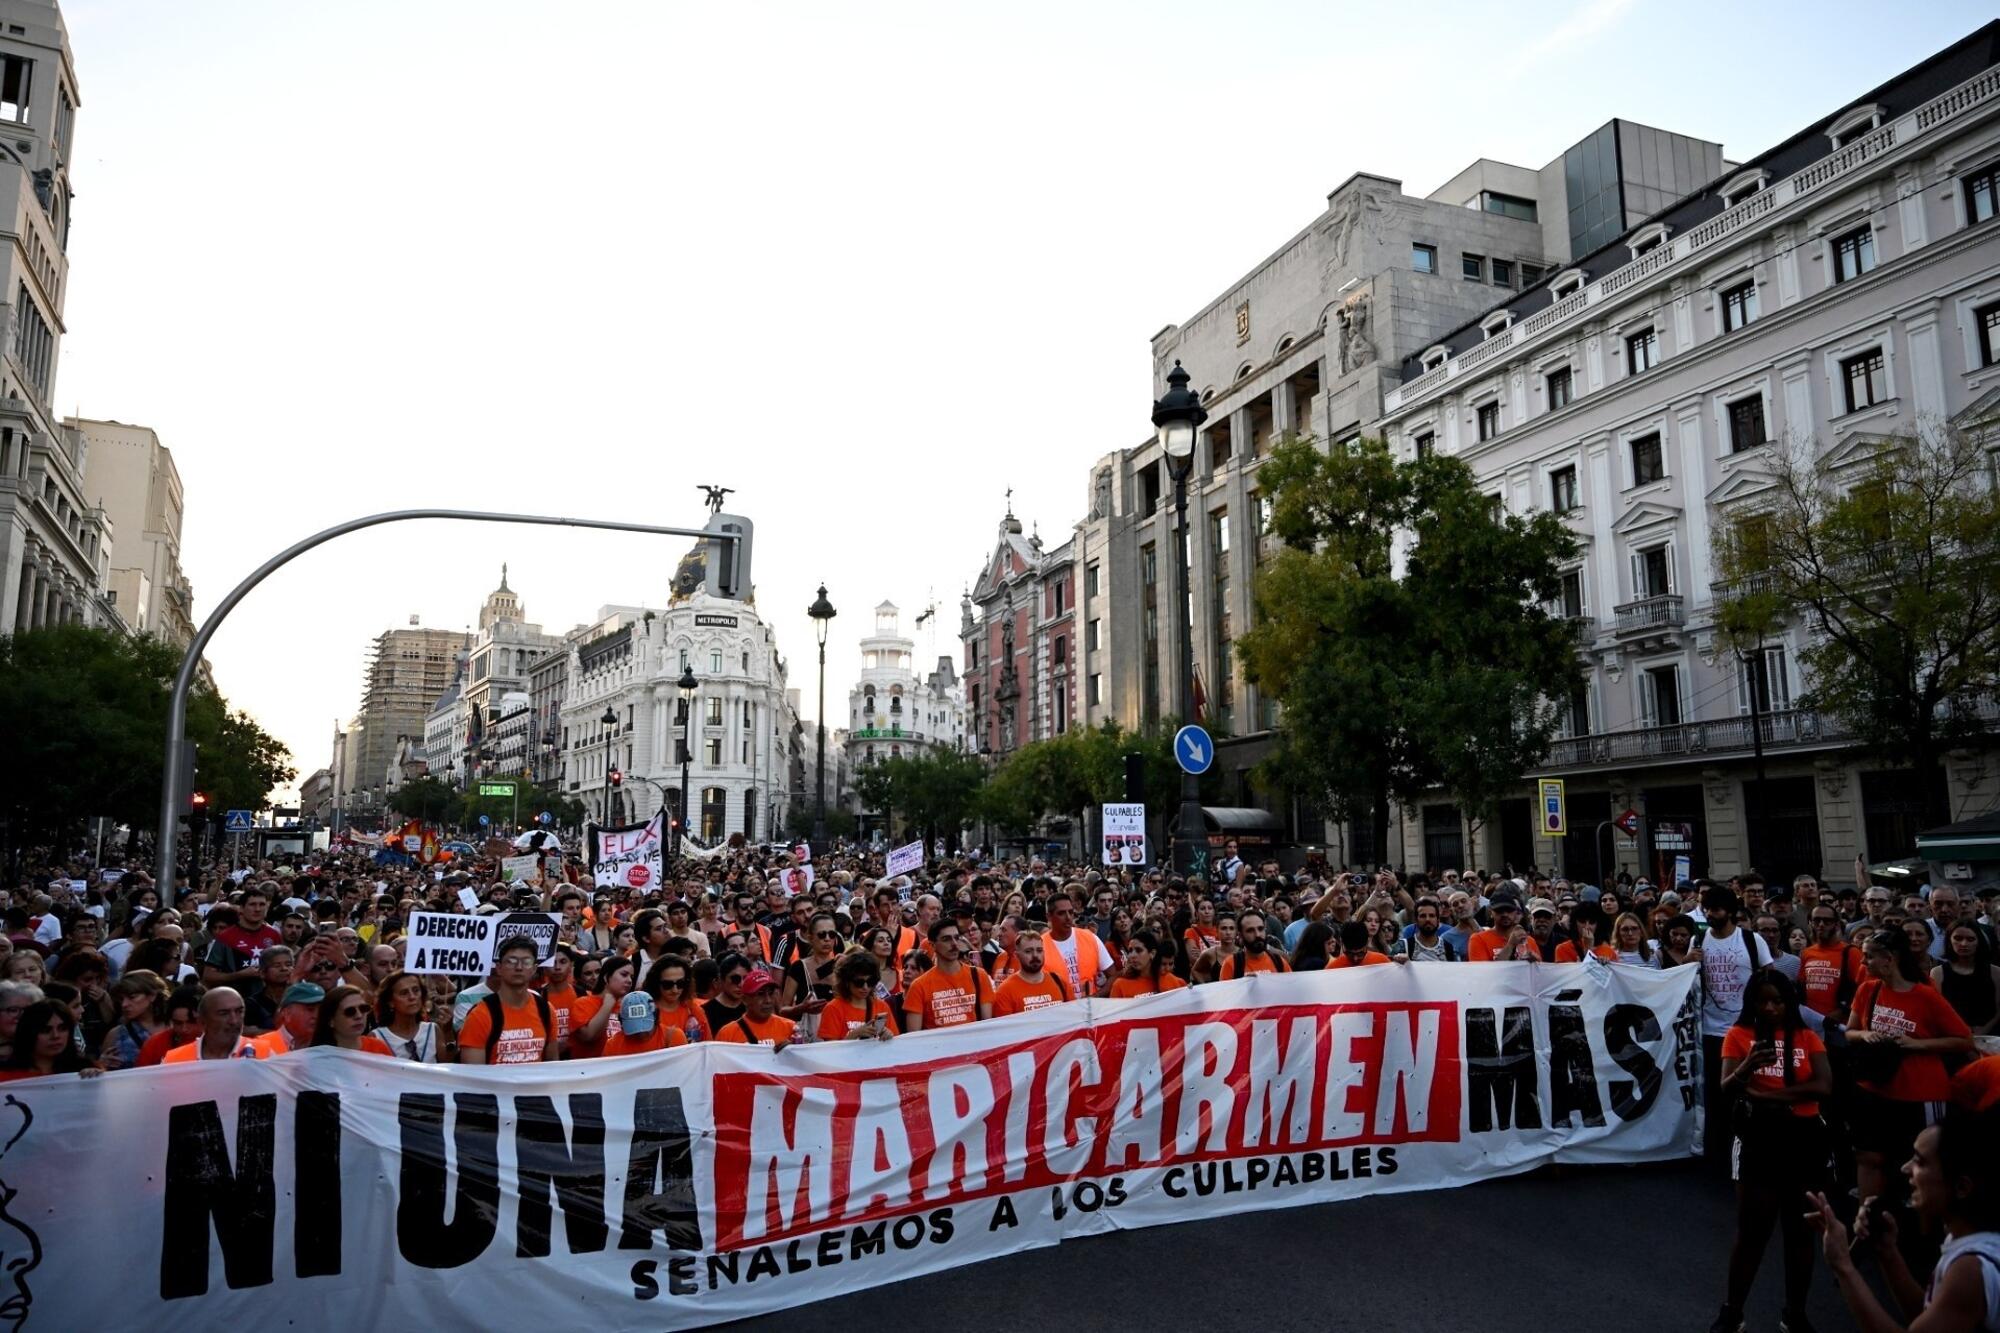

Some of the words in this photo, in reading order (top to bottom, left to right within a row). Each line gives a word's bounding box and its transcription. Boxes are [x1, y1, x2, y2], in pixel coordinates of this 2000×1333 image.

[697, 617, 737, 626] METROPOLIS
[1105, 807, 1143, 817] CULPABLES
[629, 869, 650, 877] STOP
[416, 916, 488, 941] DERECHO
[499, 924, 554, 939] DESAHUCIOS
[414, 948, 426, 970] A
[431, 948, 484, 972] TECHO.
[933, 988, 965, 999] SINDICATO
[1023, 994, 1052, 1005] SINDICATO
[943, 1014, 967, 1024] MADRID
[499, 1028, 534, 1040] SINDICATO
[499, 1042, 509, 1052] DE
[161, 1091, 341, 1300] NI
[397, 1086, 703, 1269] UNA
[743, 1010, 1440, 1240] MARICARMEN
[1465, 989, 1663, 1133] MÁS
[989, 1195, 1019, 1231] A
[1162, 1146, 1399, 1198] CULPABLES
